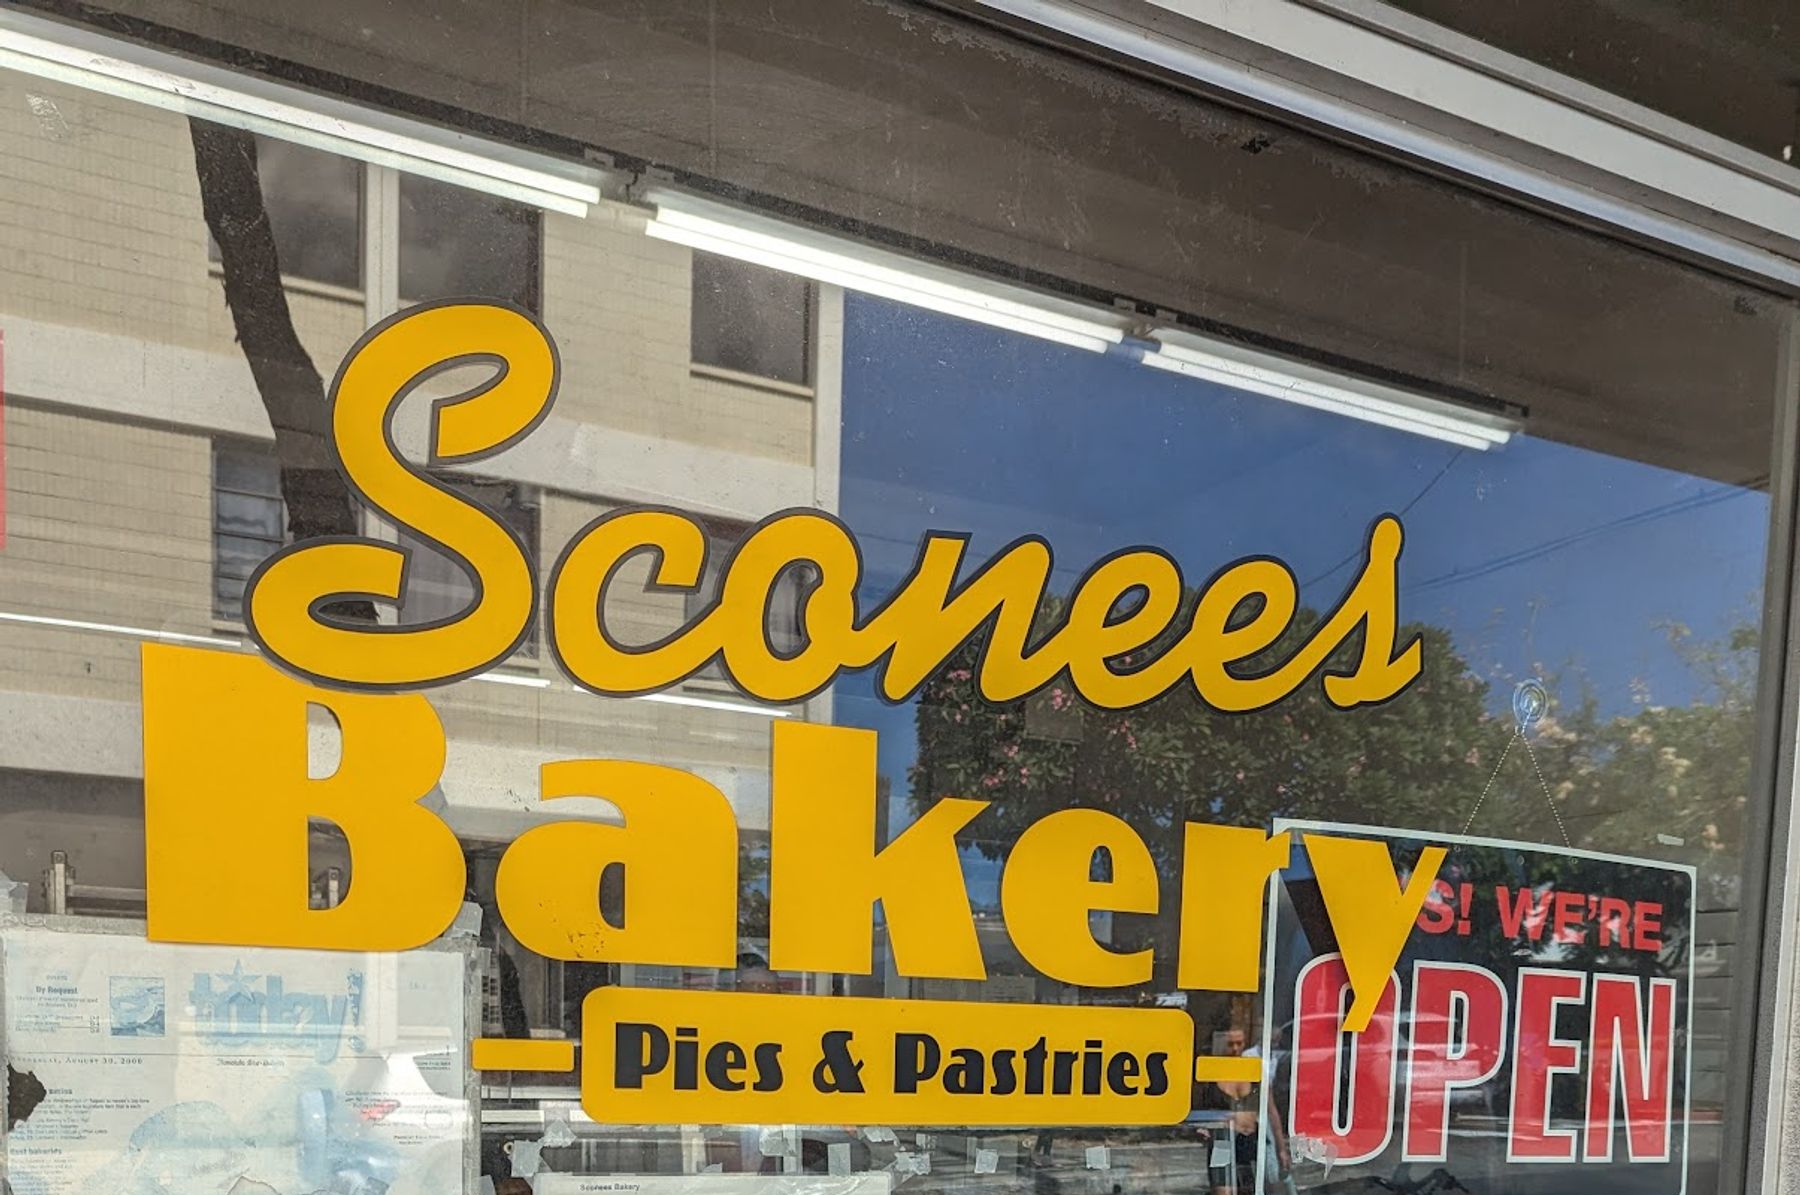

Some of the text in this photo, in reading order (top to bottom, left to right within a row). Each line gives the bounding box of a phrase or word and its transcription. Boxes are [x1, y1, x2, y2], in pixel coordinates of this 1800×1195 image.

[243, 296, 1423, 713] Sconees
[141, 641, 1447, 1032] Bakery
[1496, 885, 1663, 952] WE'RE
[614, 1022, 1170, 1097] Pies & Pastries
[1288, 951, 1677, 1166] OPEN
[580, 1183, 640, 1192] Sconees Bakery
